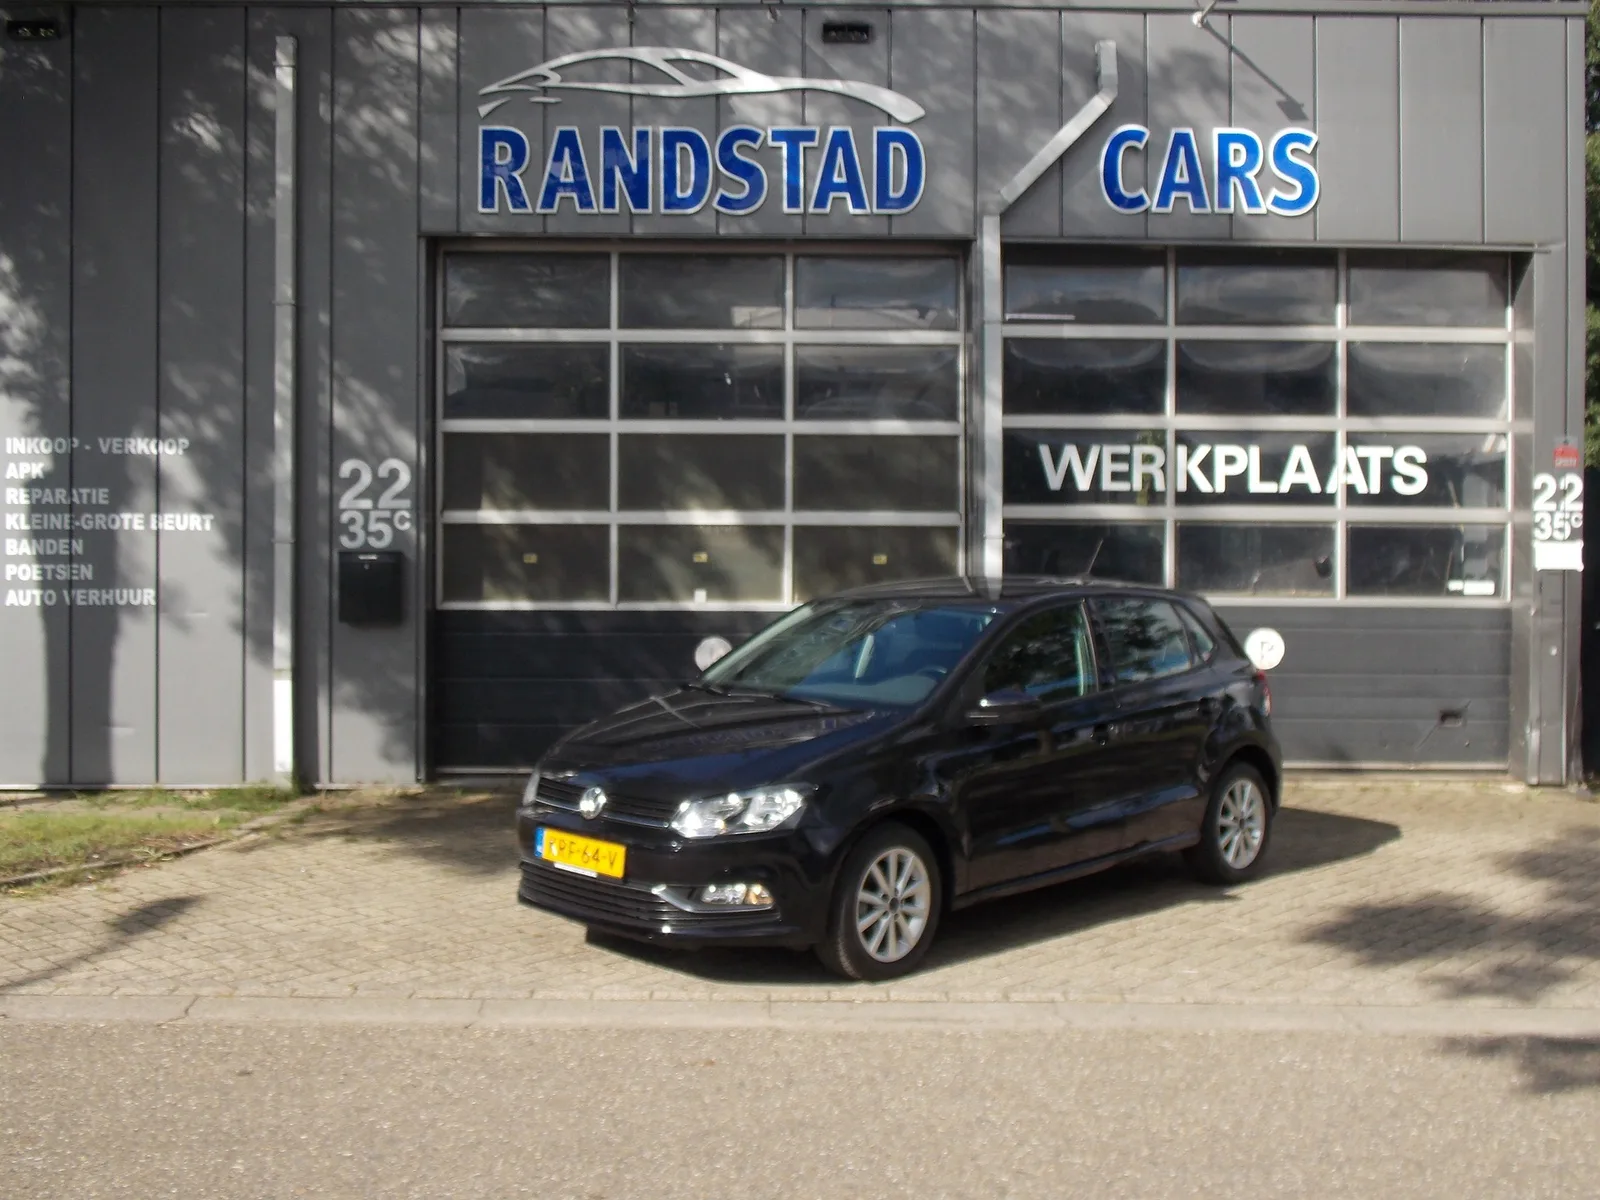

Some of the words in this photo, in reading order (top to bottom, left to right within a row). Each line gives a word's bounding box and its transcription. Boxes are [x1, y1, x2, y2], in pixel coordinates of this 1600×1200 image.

[478, 125, 927, 215] RANDSTAD
[1099, 123, 1320, 217] CARS
[5, 437, 79, 454] INKOOP
[98, 437, 190, 455] VERKOOP
[5, 462, 45, 480] APK
[1038, 444, 1428, 495] WERKPLAATS
[339, 458, 412, 509] 22
[1533, 473, 1584, 511] 22
[5, 488, 110, 505] REPARATIE
[5, 513, 145, 531] KLEINE-GROTE
[151, 513, 214, 531] BEURT
[5, 538, 83, 556] BANDEN
[5, 564, 94, 581] POETSEN
[5, 589, 56, 607] AUTO
[62, 588, 157, 607] VERHUUR
